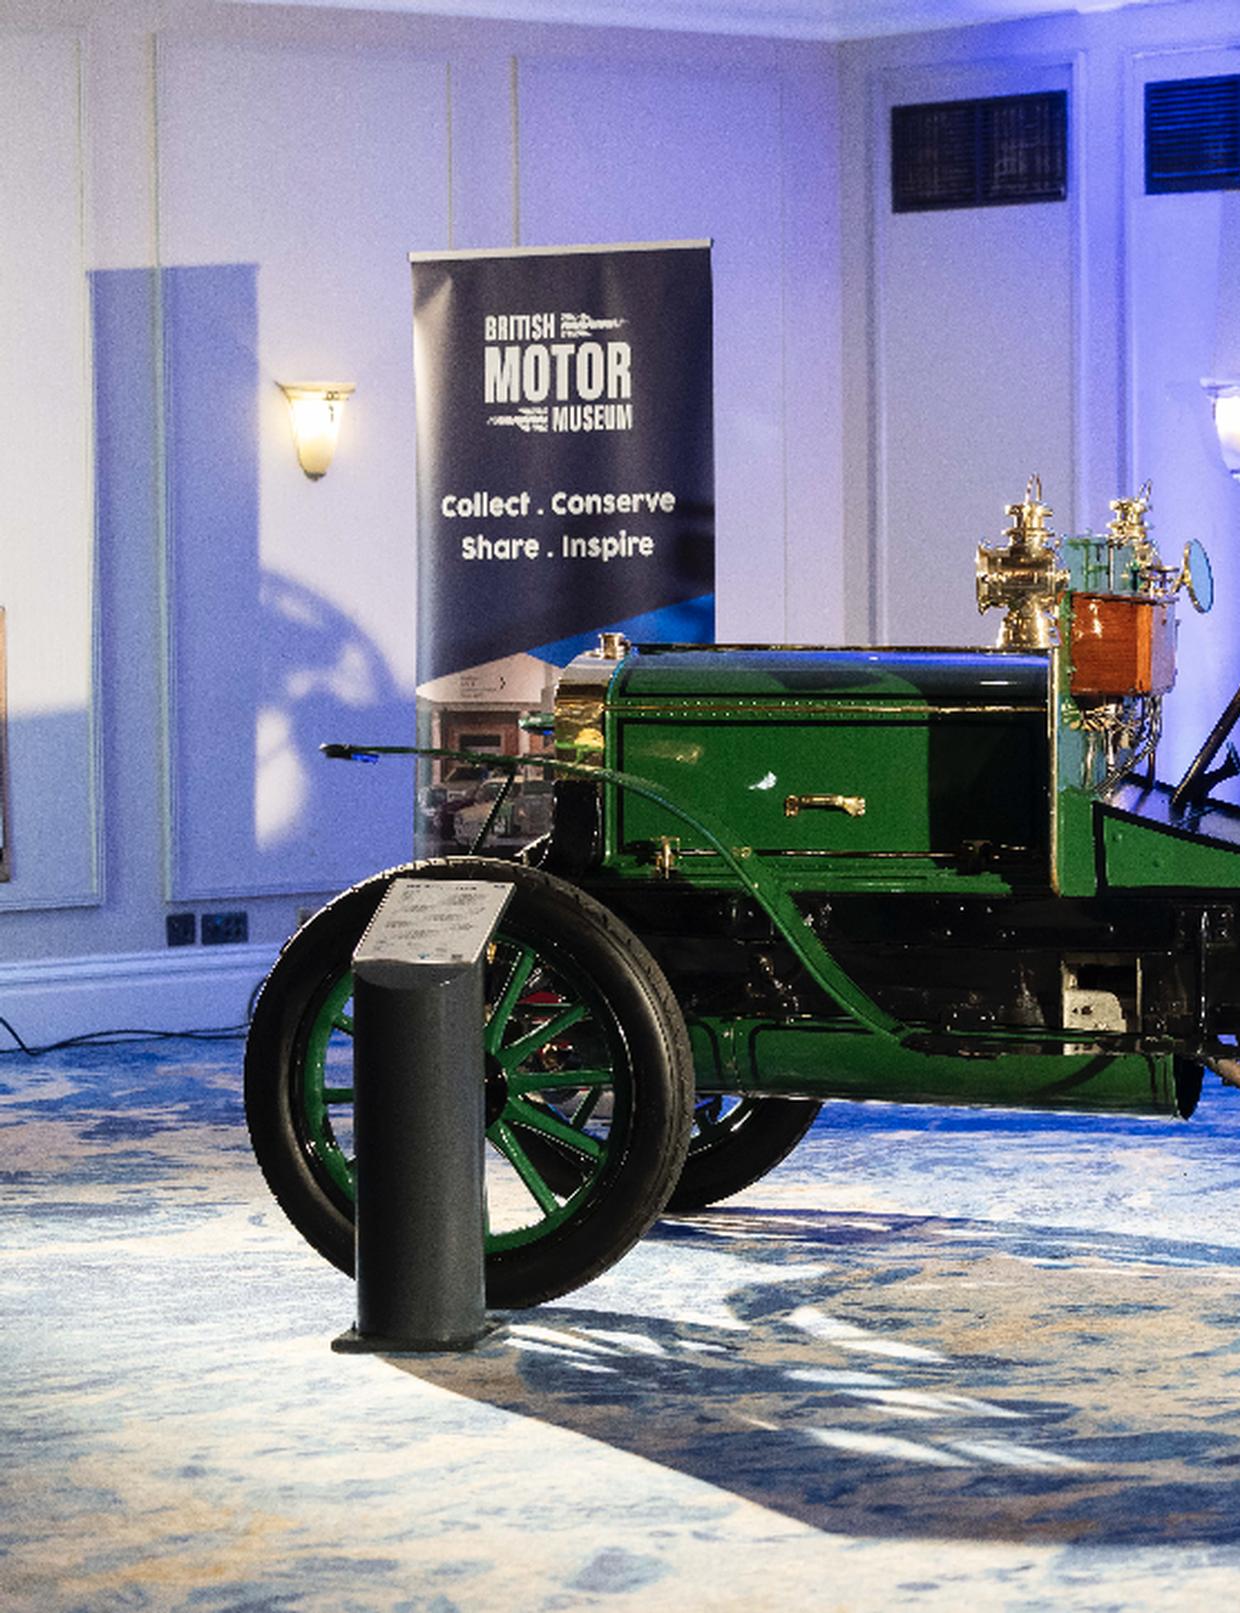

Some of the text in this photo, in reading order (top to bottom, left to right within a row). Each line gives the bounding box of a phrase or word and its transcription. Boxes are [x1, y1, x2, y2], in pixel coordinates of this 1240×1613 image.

[485, 313, 555, 341] BRITISH
[485, 342, 632, 403] MOTOR
[552, 404, 633, 432] MUSEUM
[441, 491, 530, 517] Collect
[552, 492, 675, 515] Conserve
[462, 534, 540, 560] Share
[562, 530, 655, 562] Inspire
